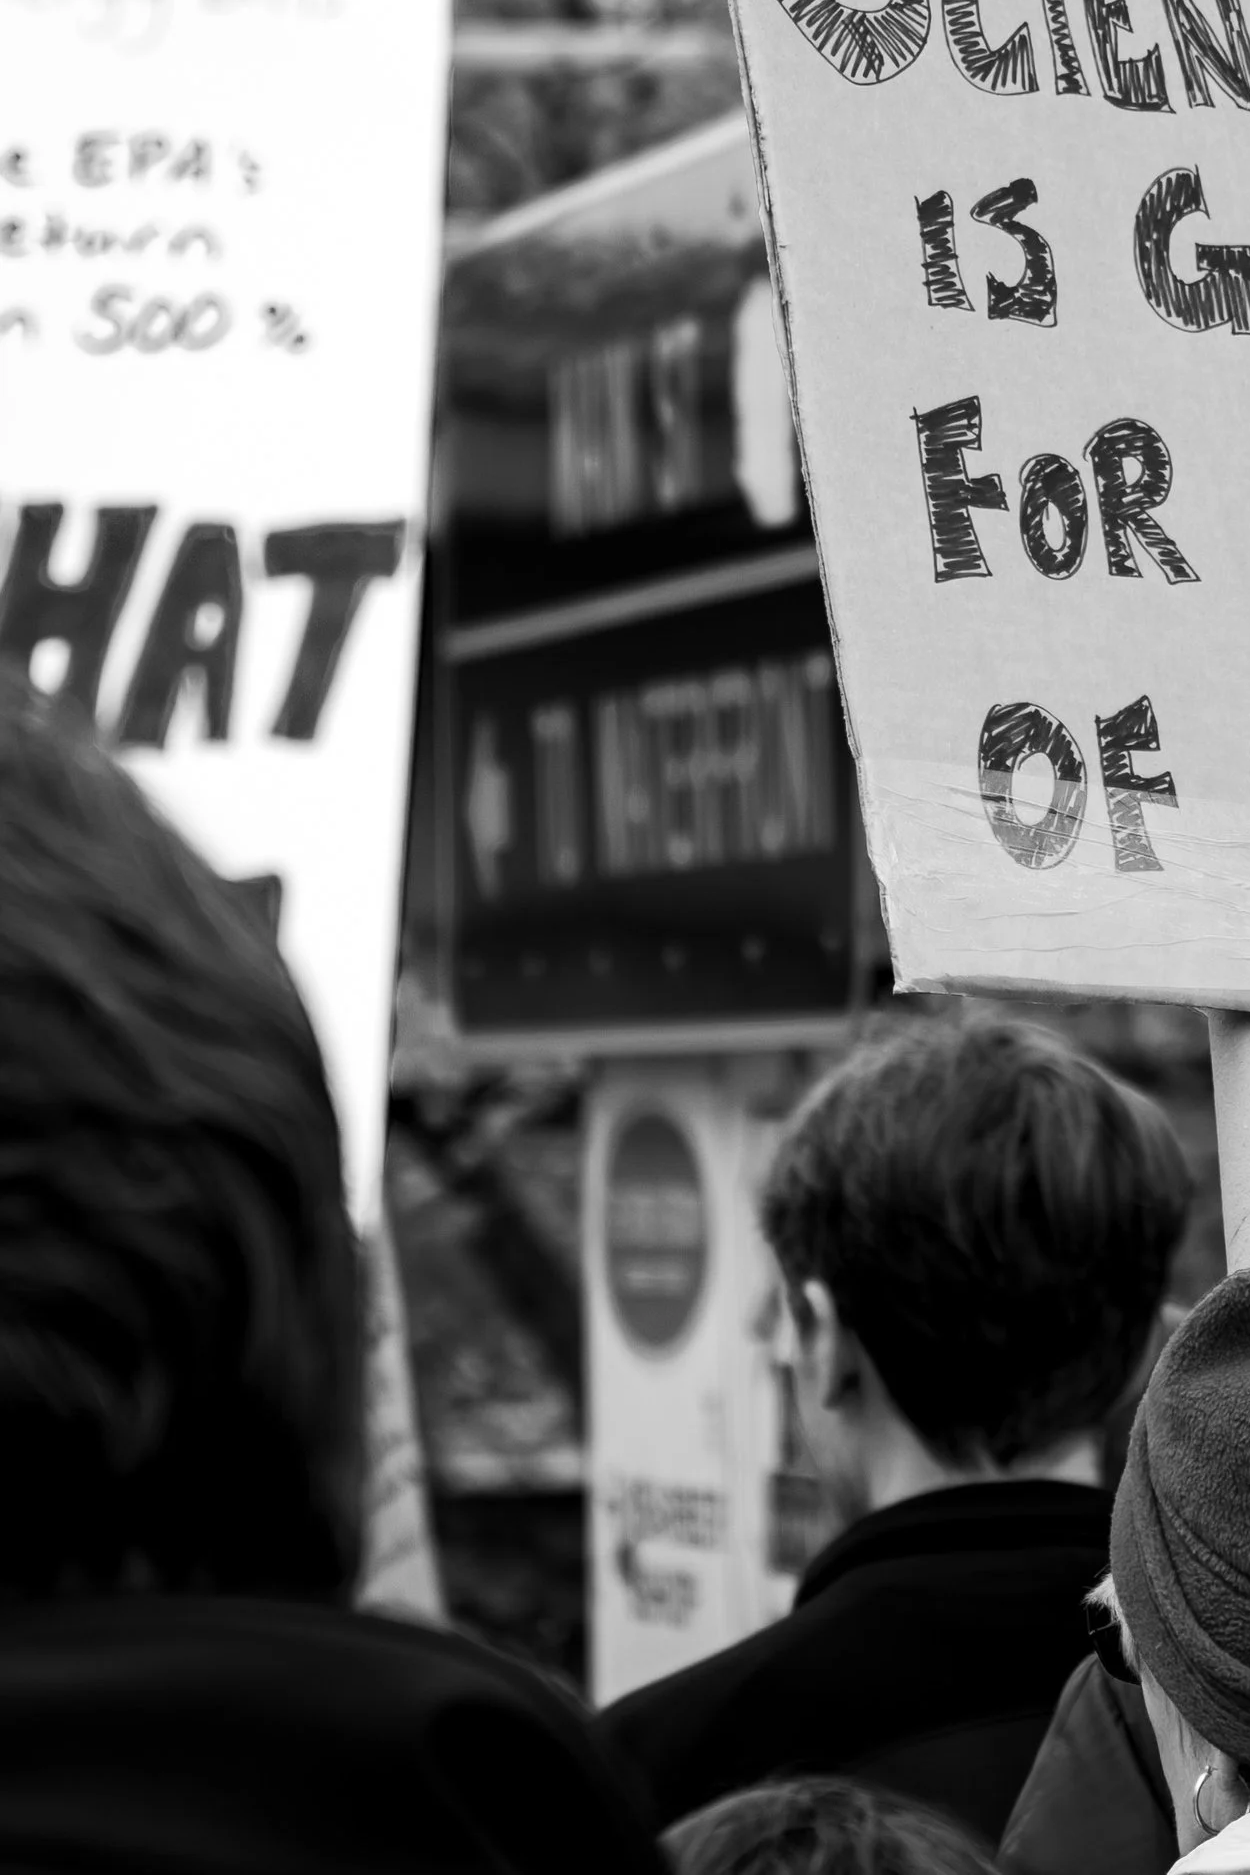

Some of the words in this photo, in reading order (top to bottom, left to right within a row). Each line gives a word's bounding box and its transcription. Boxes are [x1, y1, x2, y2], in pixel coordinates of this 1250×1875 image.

[72, 282, 234, 357] 500
[258, 299, 313, 357] %
[914, 176, 1058, 327] IS
[910, 395, 1201, 584] FOR
[977, 693, 1182, 874] OF
